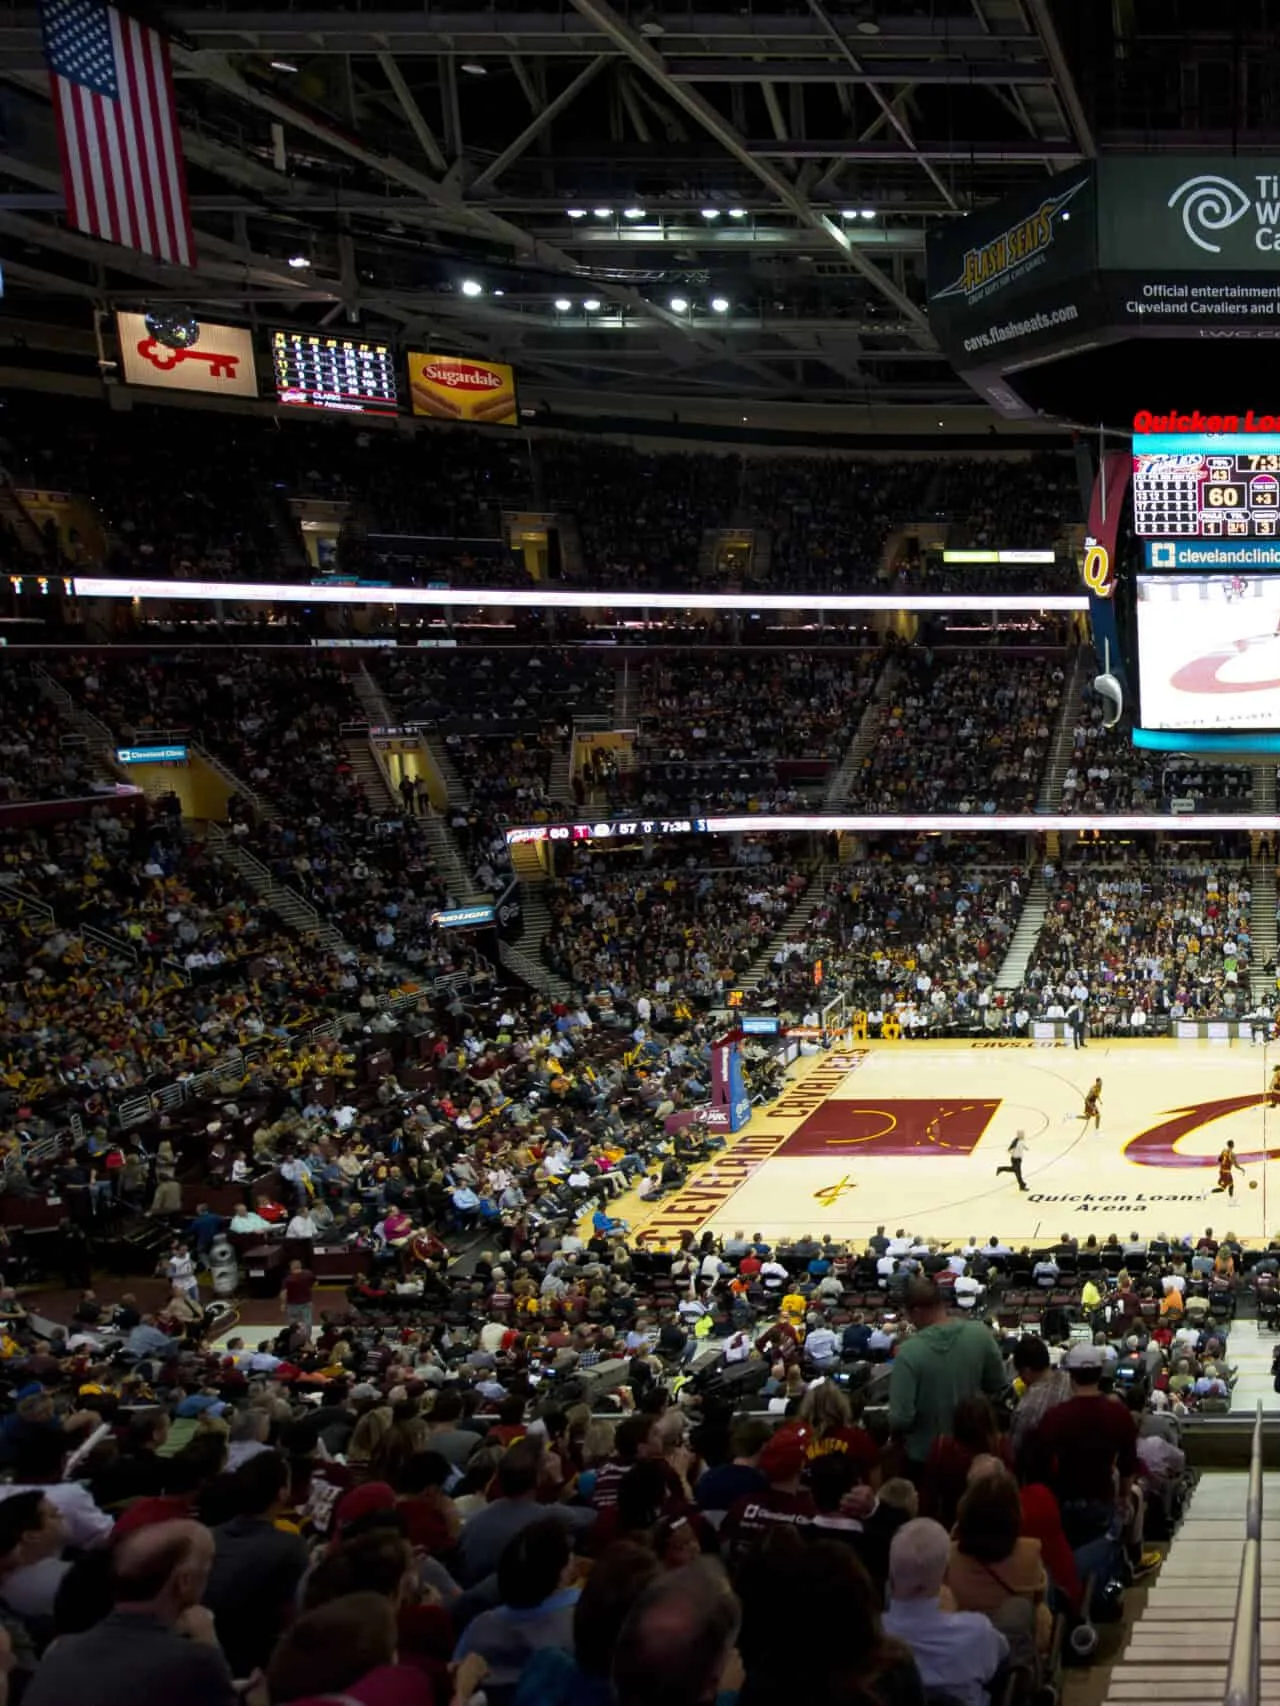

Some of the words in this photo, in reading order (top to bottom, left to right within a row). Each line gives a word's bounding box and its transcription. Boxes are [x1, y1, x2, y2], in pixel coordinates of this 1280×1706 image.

[1008, 205, 1055, 265] SEATS
[961, 236, 1007, 291] FLASH
[1143, 285, 1188, 297] Official
[1191, 286, 1280, 298] entertainment
[1126, 302, 1188, 314] Cleveland
[1190, 302, 1248, 314] Cavaliers
[1250, 302, 1274, 314] and
[964, 304, 1079, 351] cavs.flashseats.com
[425, 366, 501, 387] Sugardale
[1133, 410, 1239, 434] Quicken
[1209, 488, 1238, 506] 60
[1255, 493, 1271, 505] +3
[1261, 521, 1270, 533] 3
[1084, 545, 1111, 596] Q
[550, 828, 569, 838] 60
[618, 823, 638, 834] 57
[660, 821, 692, 833] 7:38
[767, 1048, 870, 1119] CAVALIERS
[636, 1135, 785, 1242] CLEVELAND
[1026, 1193, 1128, 1203] Quicken
[1134, 1193, 1206, 1202] Loans
[1074, 1203, 1148, 1212] Arena
